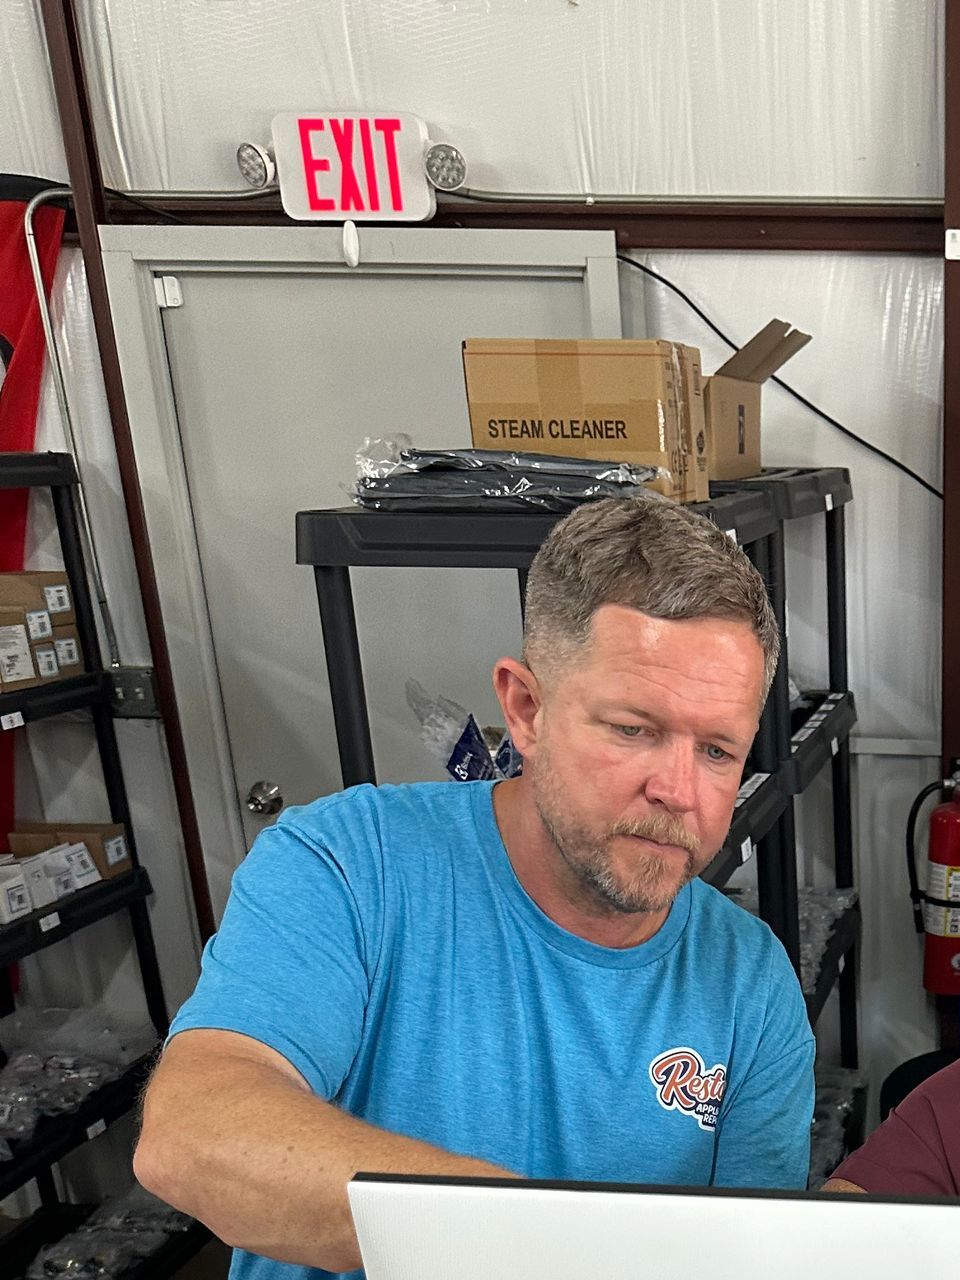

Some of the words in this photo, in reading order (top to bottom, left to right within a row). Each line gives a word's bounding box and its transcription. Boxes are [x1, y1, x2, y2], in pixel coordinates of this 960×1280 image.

[297, 118, 403, 211] EXIT
[488, 419, 544, 439] STEAM
[549, 419, 628, 440] CLEANER
